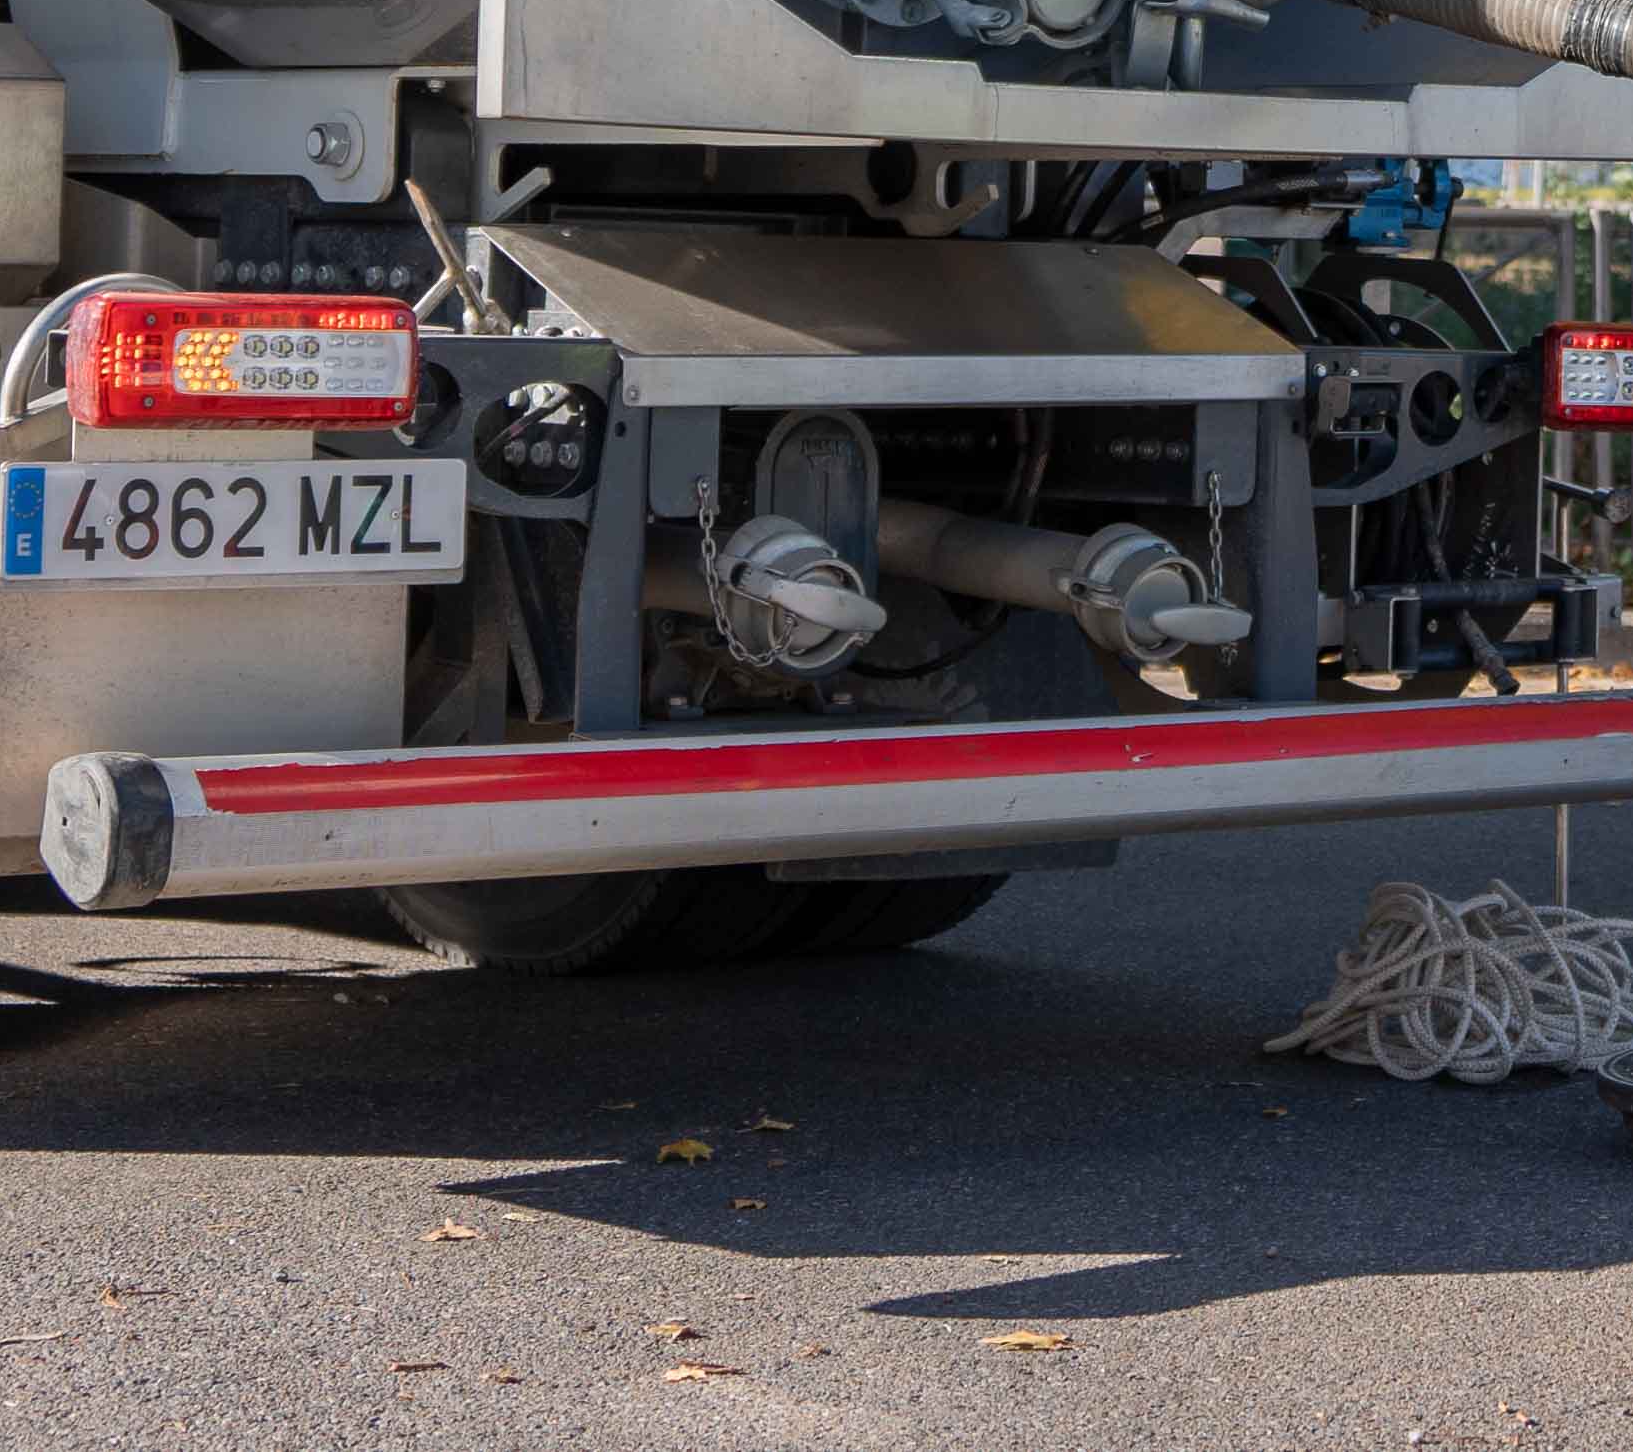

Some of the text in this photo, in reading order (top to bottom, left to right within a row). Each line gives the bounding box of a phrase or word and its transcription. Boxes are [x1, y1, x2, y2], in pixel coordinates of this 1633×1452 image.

[16, 531, 31, 557] E
[62, 474, 442, 561] 4862 MZL
